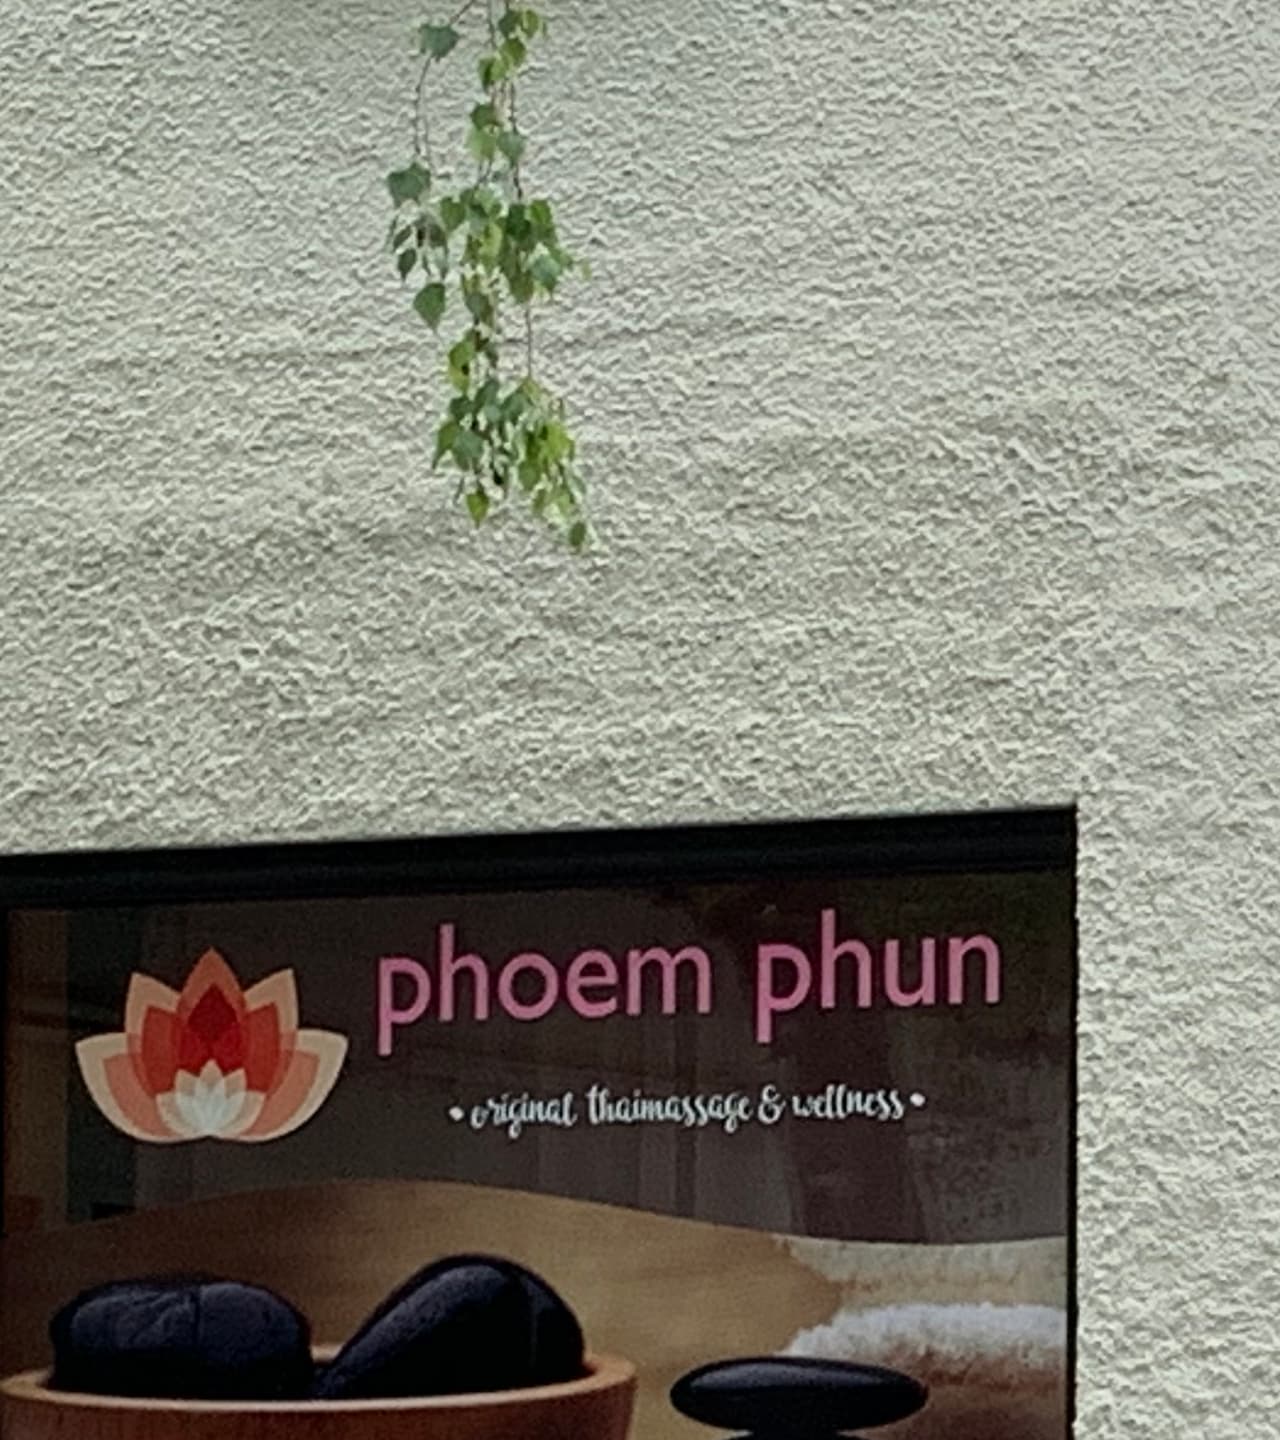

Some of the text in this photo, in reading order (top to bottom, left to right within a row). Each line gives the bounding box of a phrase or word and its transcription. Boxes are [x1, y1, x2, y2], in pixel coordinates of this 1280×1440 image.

[377, 907, 1001, 1057] phoem phun
[470, 1083, 904, 1140] original thaimassage & wellness
